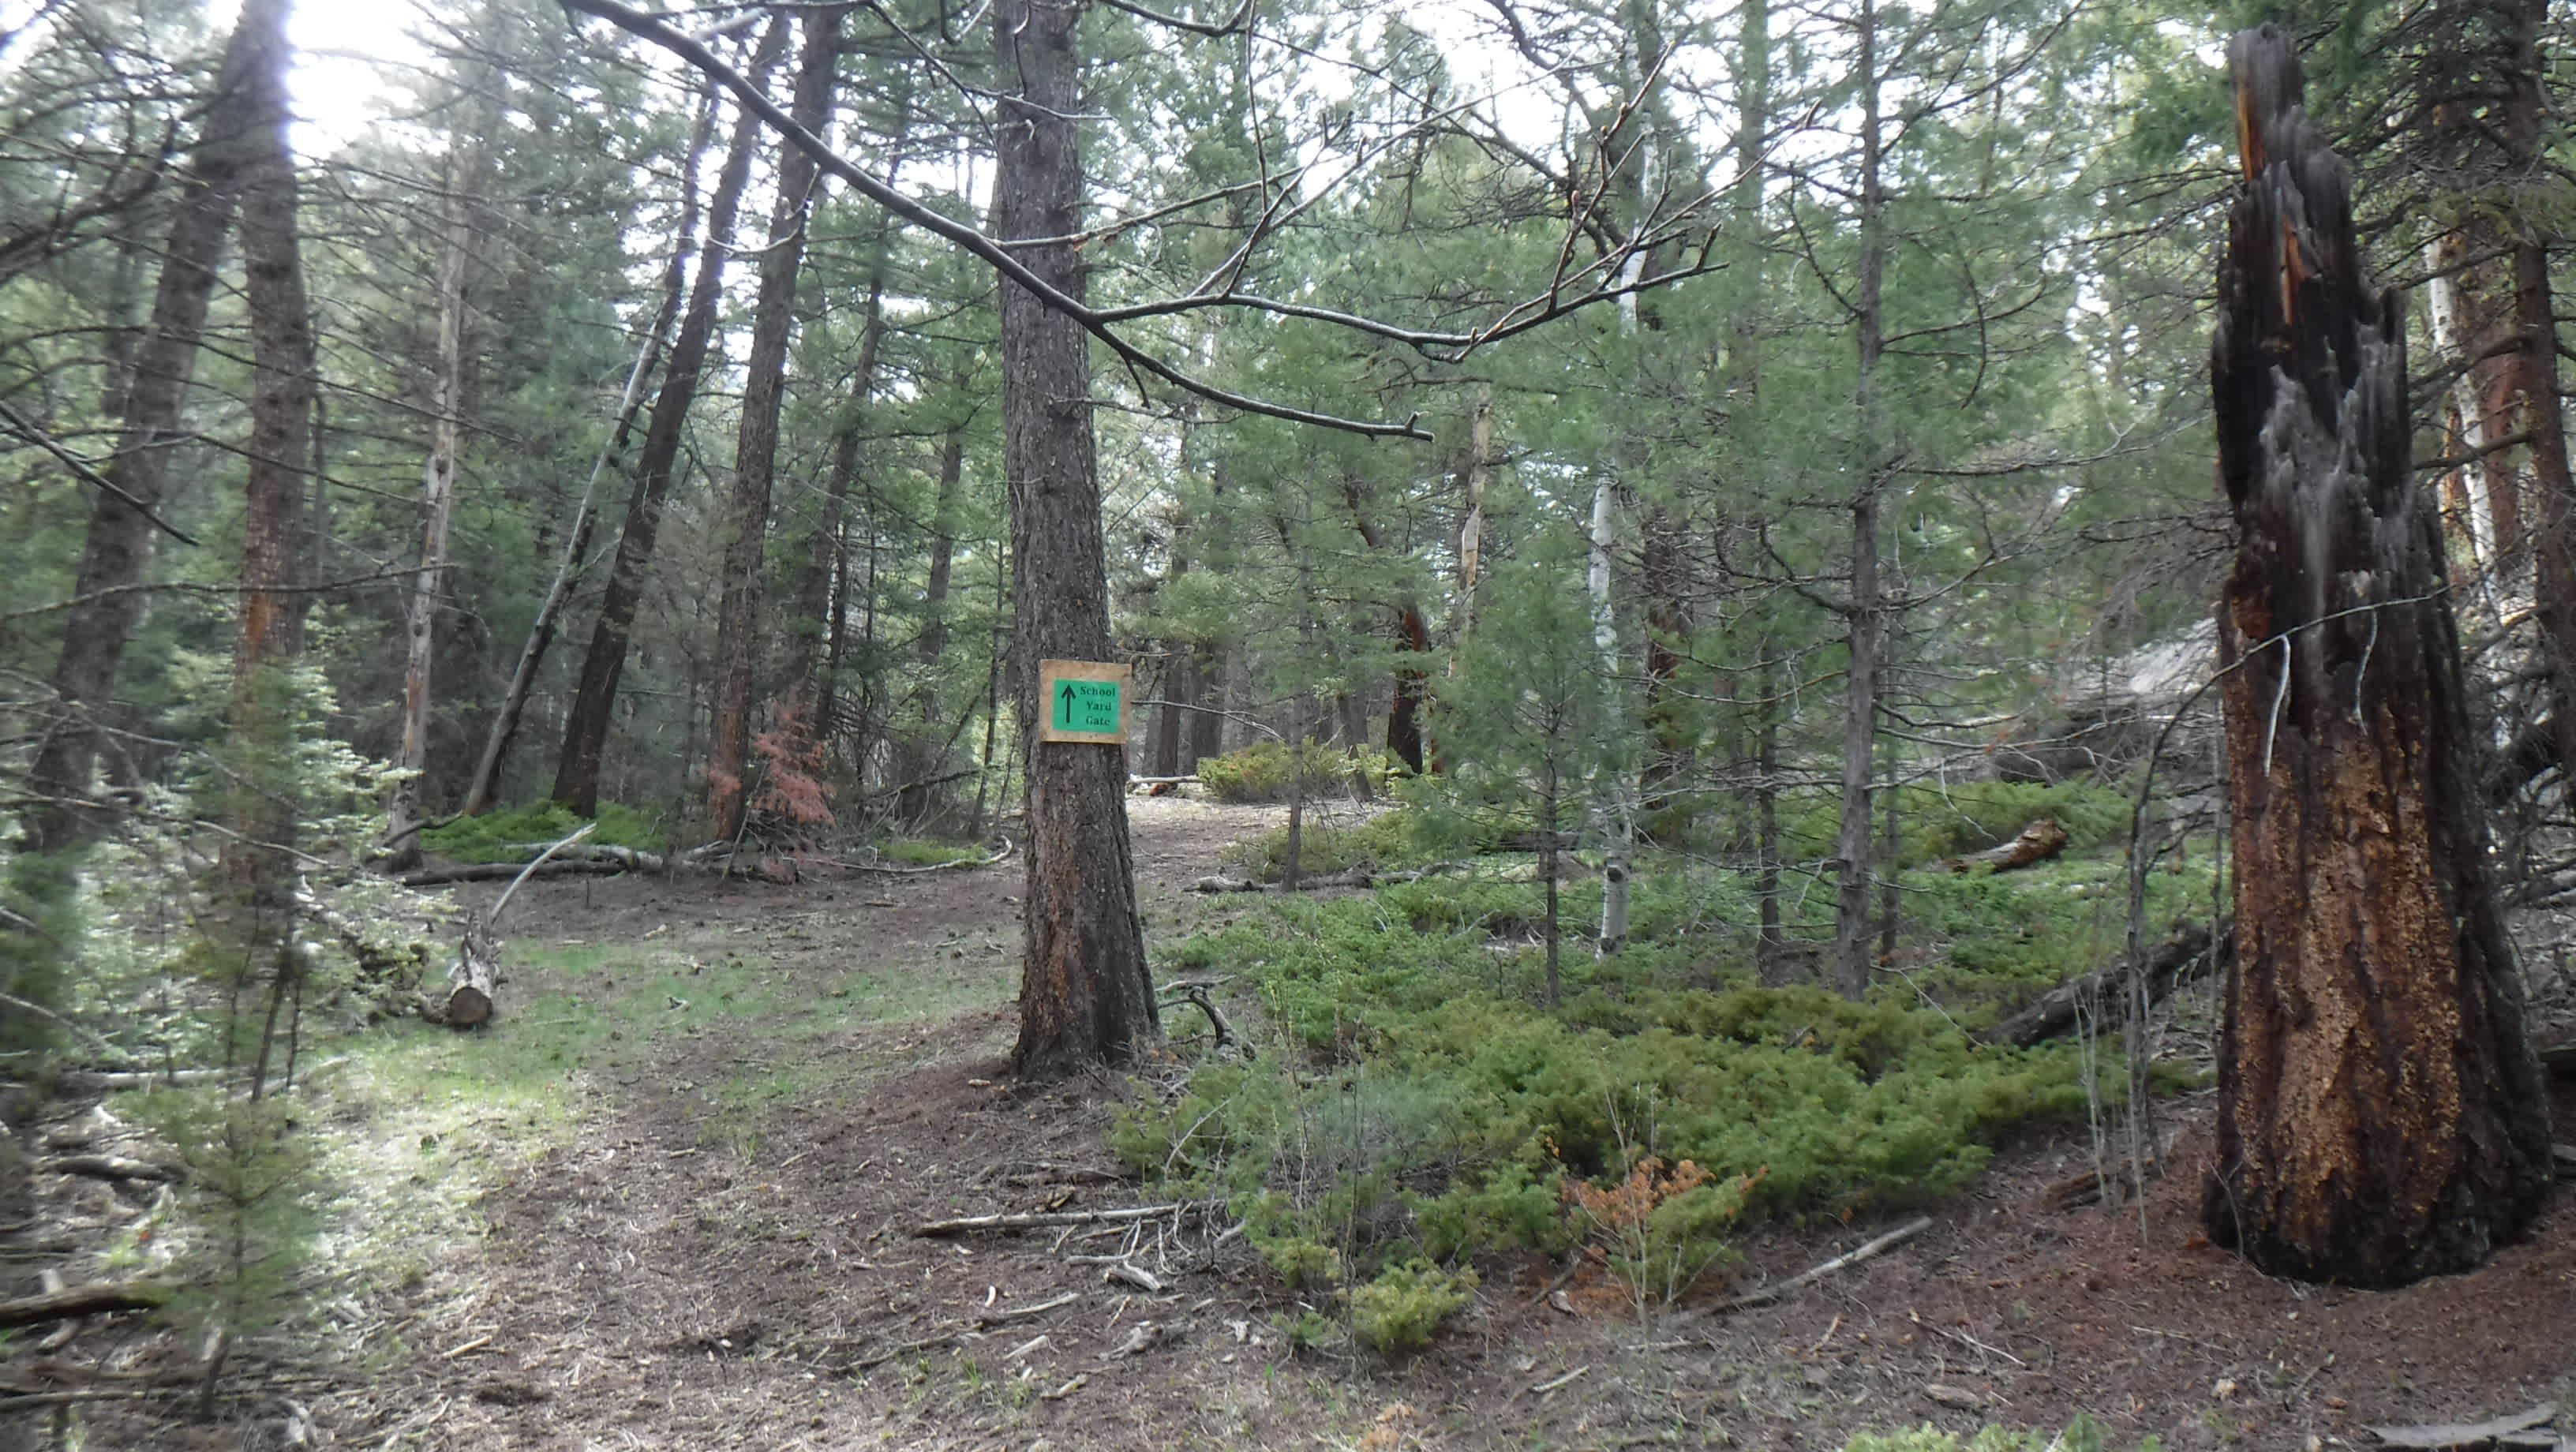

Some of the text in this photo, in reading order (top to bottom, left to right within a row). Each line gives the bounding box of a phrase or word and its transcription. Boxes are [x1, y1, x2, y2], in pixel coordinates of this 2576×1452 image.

[1080, 686, 1115, 697] School
[1086, 701, 1112, 711] Yard
[1086, 716, 1110, 726] Gate
